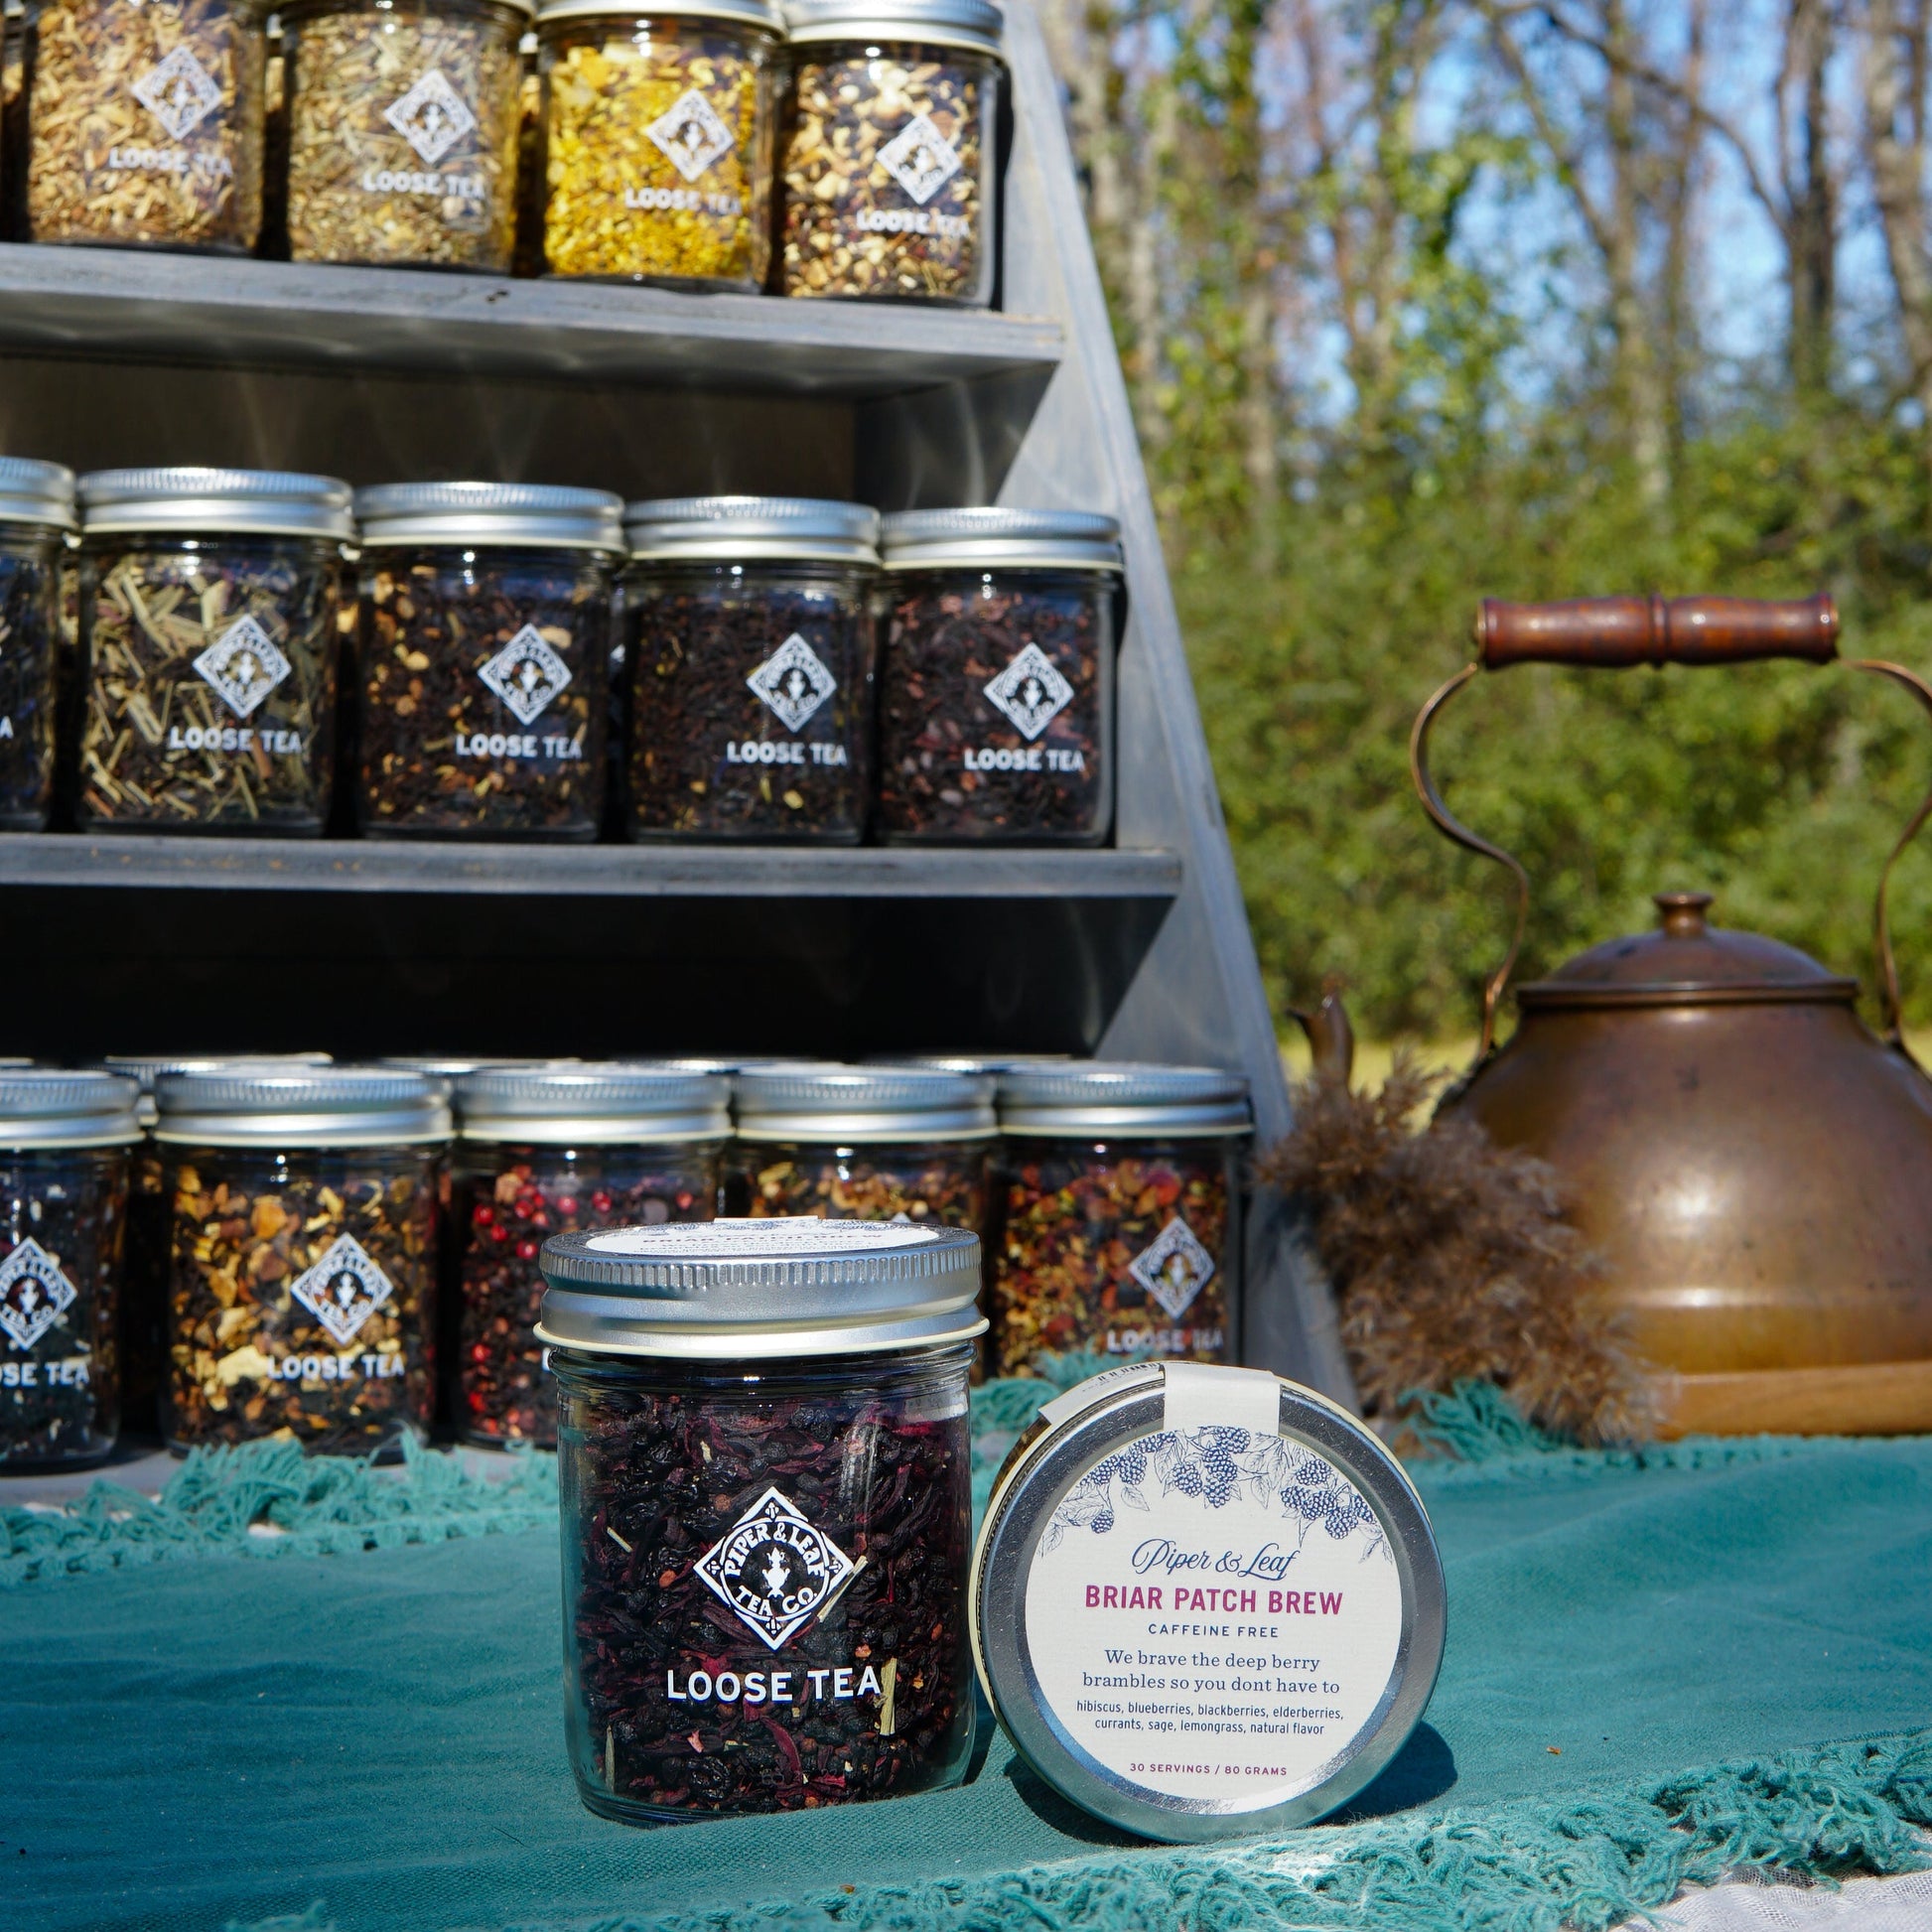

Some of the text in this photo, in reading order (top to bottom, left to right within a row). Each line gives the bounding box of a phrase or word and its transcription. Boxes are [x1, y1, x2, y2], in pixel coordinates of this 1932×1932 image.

[109, 146, 190, 173] LOOSE
[363, 171, 485, 198] LOOSE TEA
[625, 187, 701, 211] LOOSE
[856, 208, 931, 234] LOOSE
[170, 725, 302, 754] LOOSE TEA
[456, 733, 583, 759] LOOSE TEA
[727, 741, 848, 766] LOOSE TEA
[963, 747, 1086, 772] LOOSE TEA
[45, 1361, 90, 1386] TEA
[267, 1353, 405, 1381] LOOSE TEA
[724, 1523, 771, 1577] PIPER
[773, 1522, 787, 1544] &
[1132, 1538, 1301, 1582] Piper & Leaf
[736, 1585, 817, 1616] TEA CO.
[1085, 1585, 1343, 1615] BRIAR PATCH BREW
[1148, 1623, 1279, 1638] CAFFEINE FREE
[1104, 1649, 1320, 1673] We brave the deep berry
[666, 1665, 882, 1703] LOOSE TEA
[1082, 1672, 1340, 1694] brambles so you dont have to
[1076, 1700, 1344, 1721] hibiscus, blueberries, blackberries, elderberries,
[1094, 1719, 1325, 1735] currants, sage, lemongrass, natural flavor
[1130, 1763, 1288, 1776] 30 SERVINGS / 80 GRAMS
